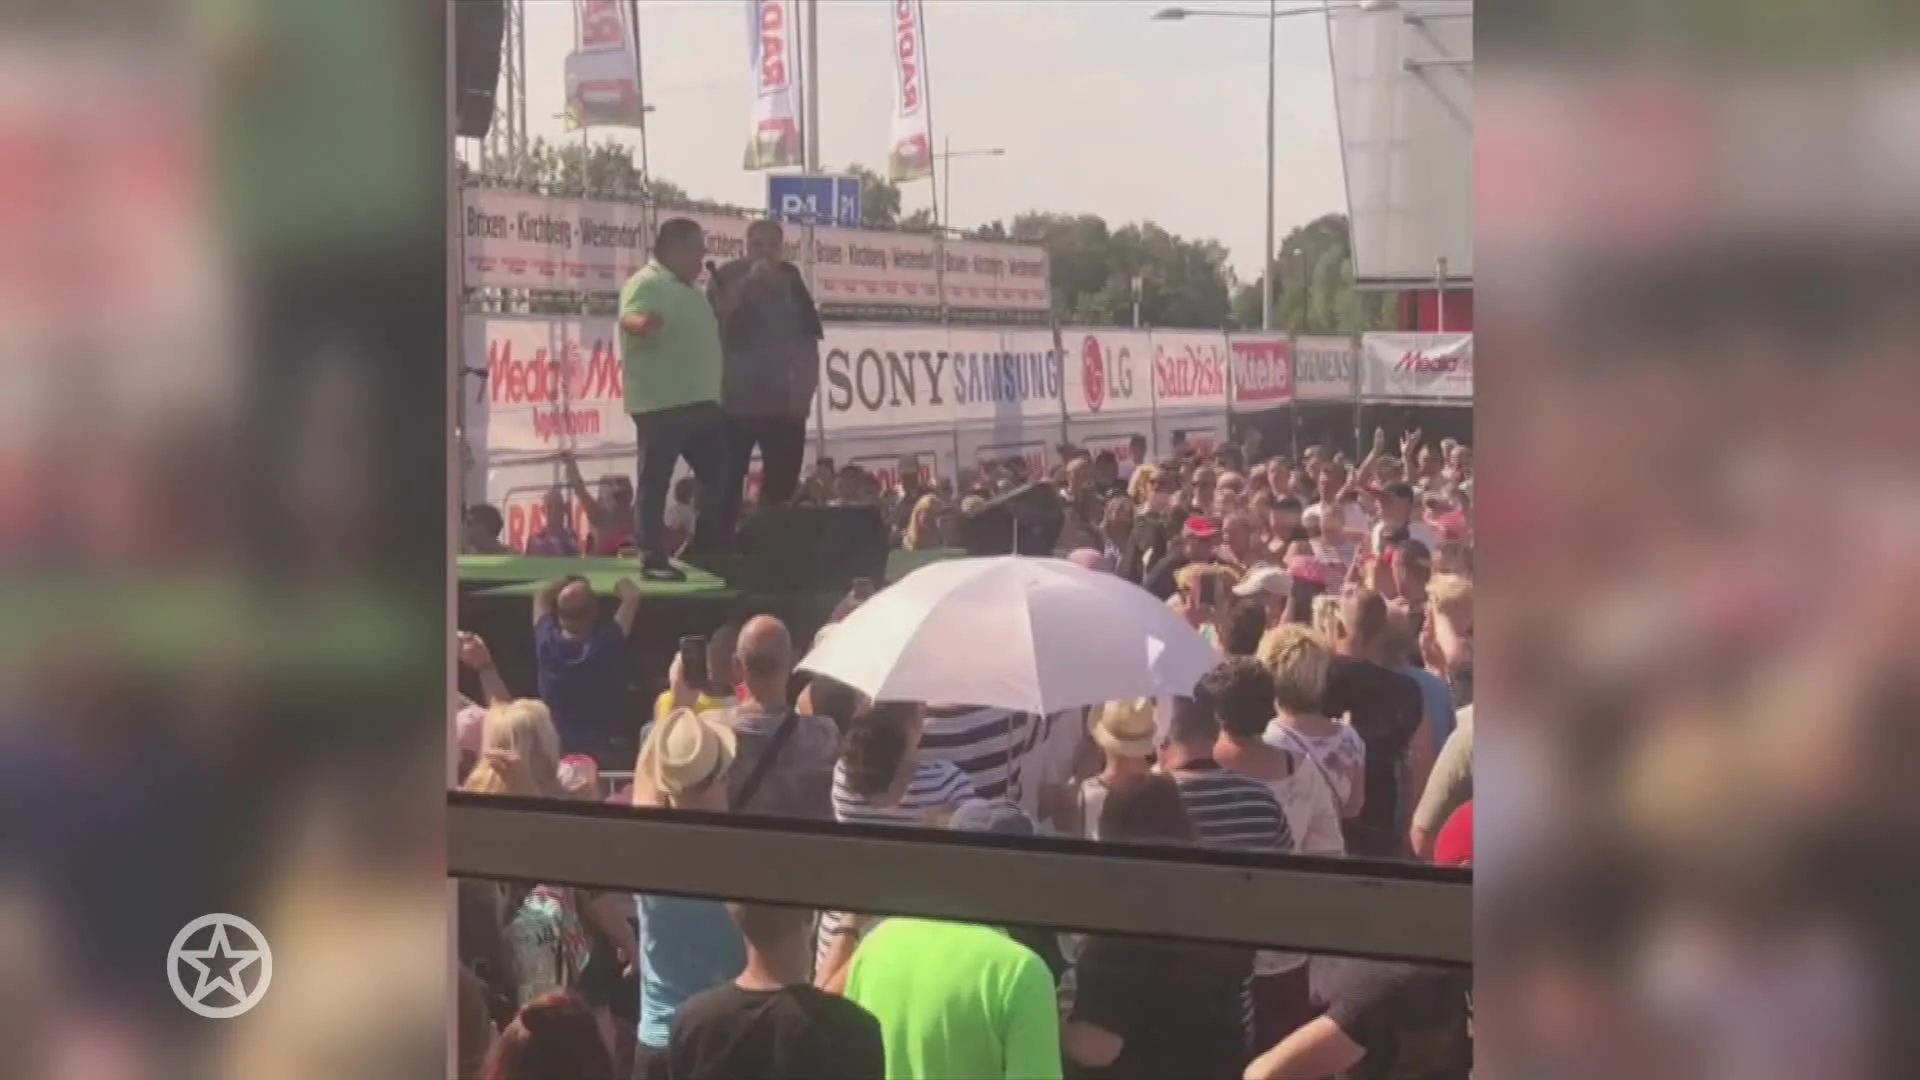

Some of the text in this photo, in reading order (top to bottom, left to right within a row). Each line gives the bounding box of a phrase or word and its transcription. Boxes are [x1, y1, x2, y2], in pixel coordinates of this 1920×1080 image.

[762, 0, 787, 87] RAD
[467, 205, 641, 248] Brixen Kirchberg Westendorf
[703, 234, 745, 257] irchberg
[478, 339, 560, 403] Media
[825, 348, 949, 411] SONY
[953, 350, 1062, 404] SAMSUNG
[1105, 345, 1133, 399] LG
[1155, 344, 1224, 396] SanDisk
[1233, 350, 1287, 392] Miele
